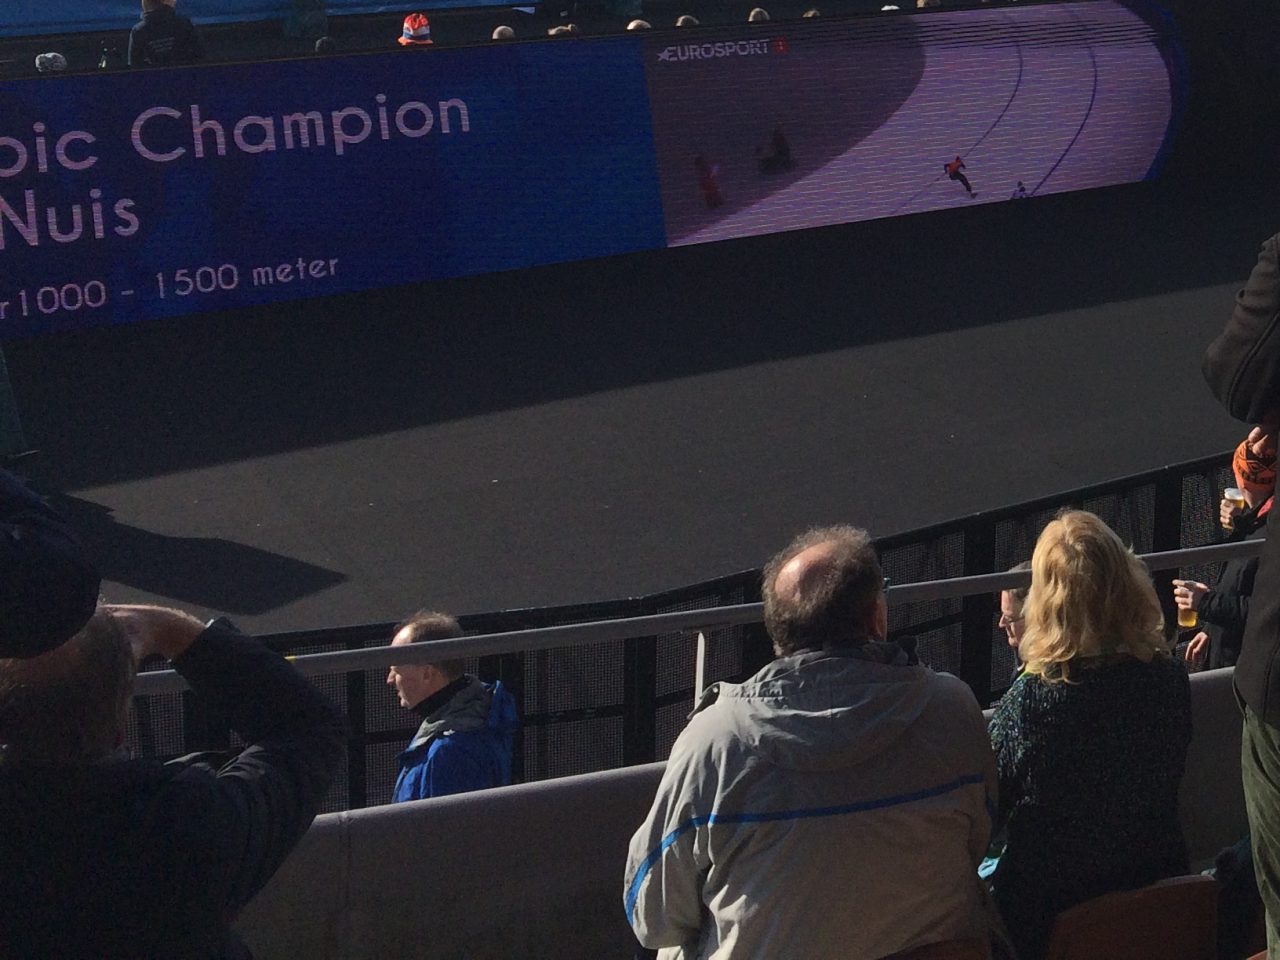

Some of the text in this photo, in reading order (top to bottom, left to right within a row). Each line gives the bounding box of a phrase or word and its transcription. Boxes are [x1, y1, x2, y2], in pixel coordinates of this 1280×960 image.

[666, 39, 771, 62] EUROSPORT
[131, 93, 470, 163] Champion
[0, 188, 140, 250] Nuis
[156, 263, 239, 300] 1500
[252, 255, 339, 288] meter
